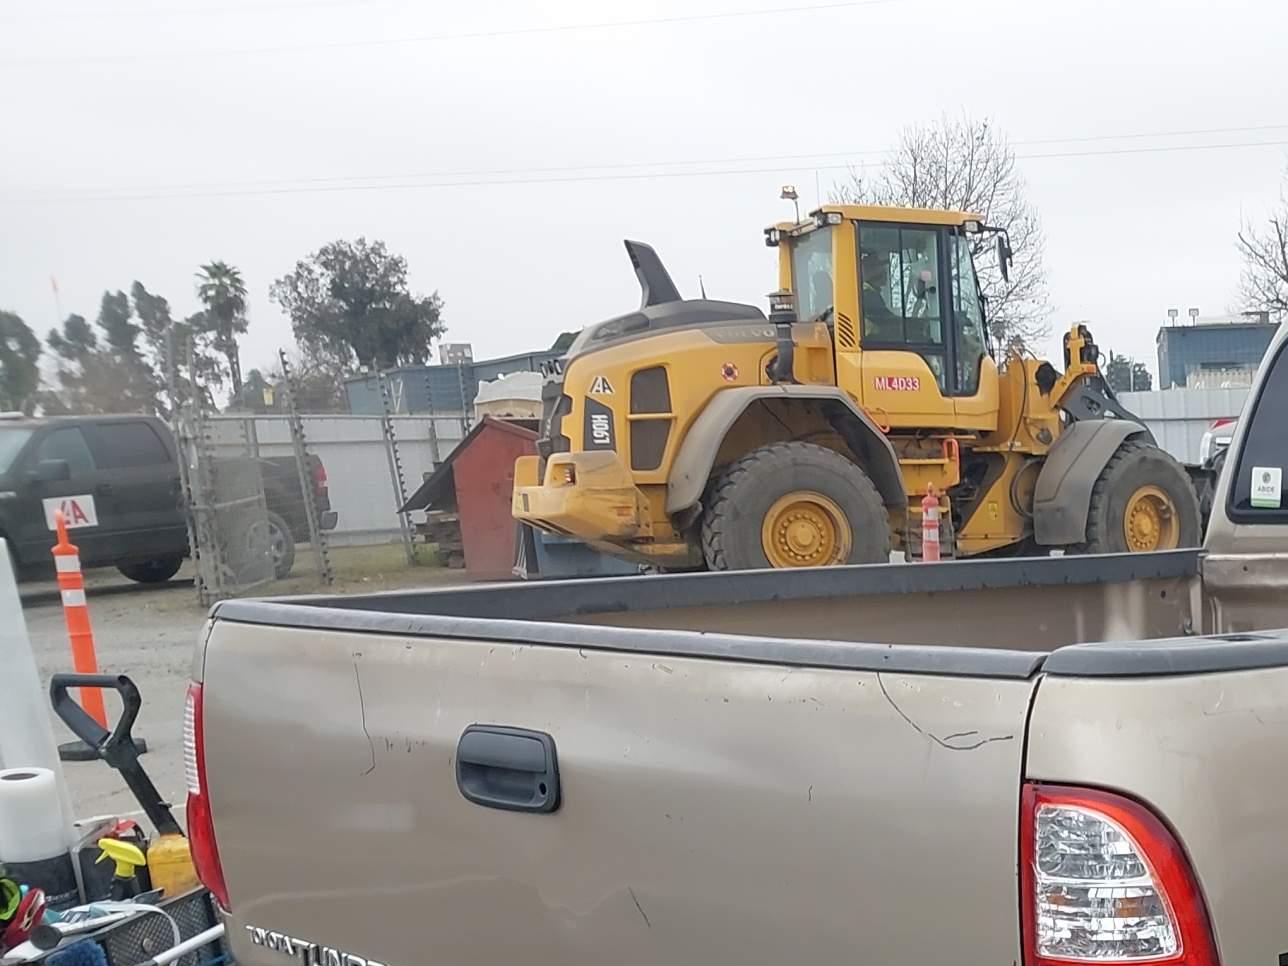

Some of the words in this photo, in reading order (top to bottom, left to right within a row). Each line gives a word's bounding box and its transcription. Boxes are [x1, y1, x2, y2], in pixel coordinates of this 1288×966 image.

[874, 376, 920, 391] ML4D33
[591, 414, 610, 444] L90H
[246, 925, 294, 955] TOYOTA
